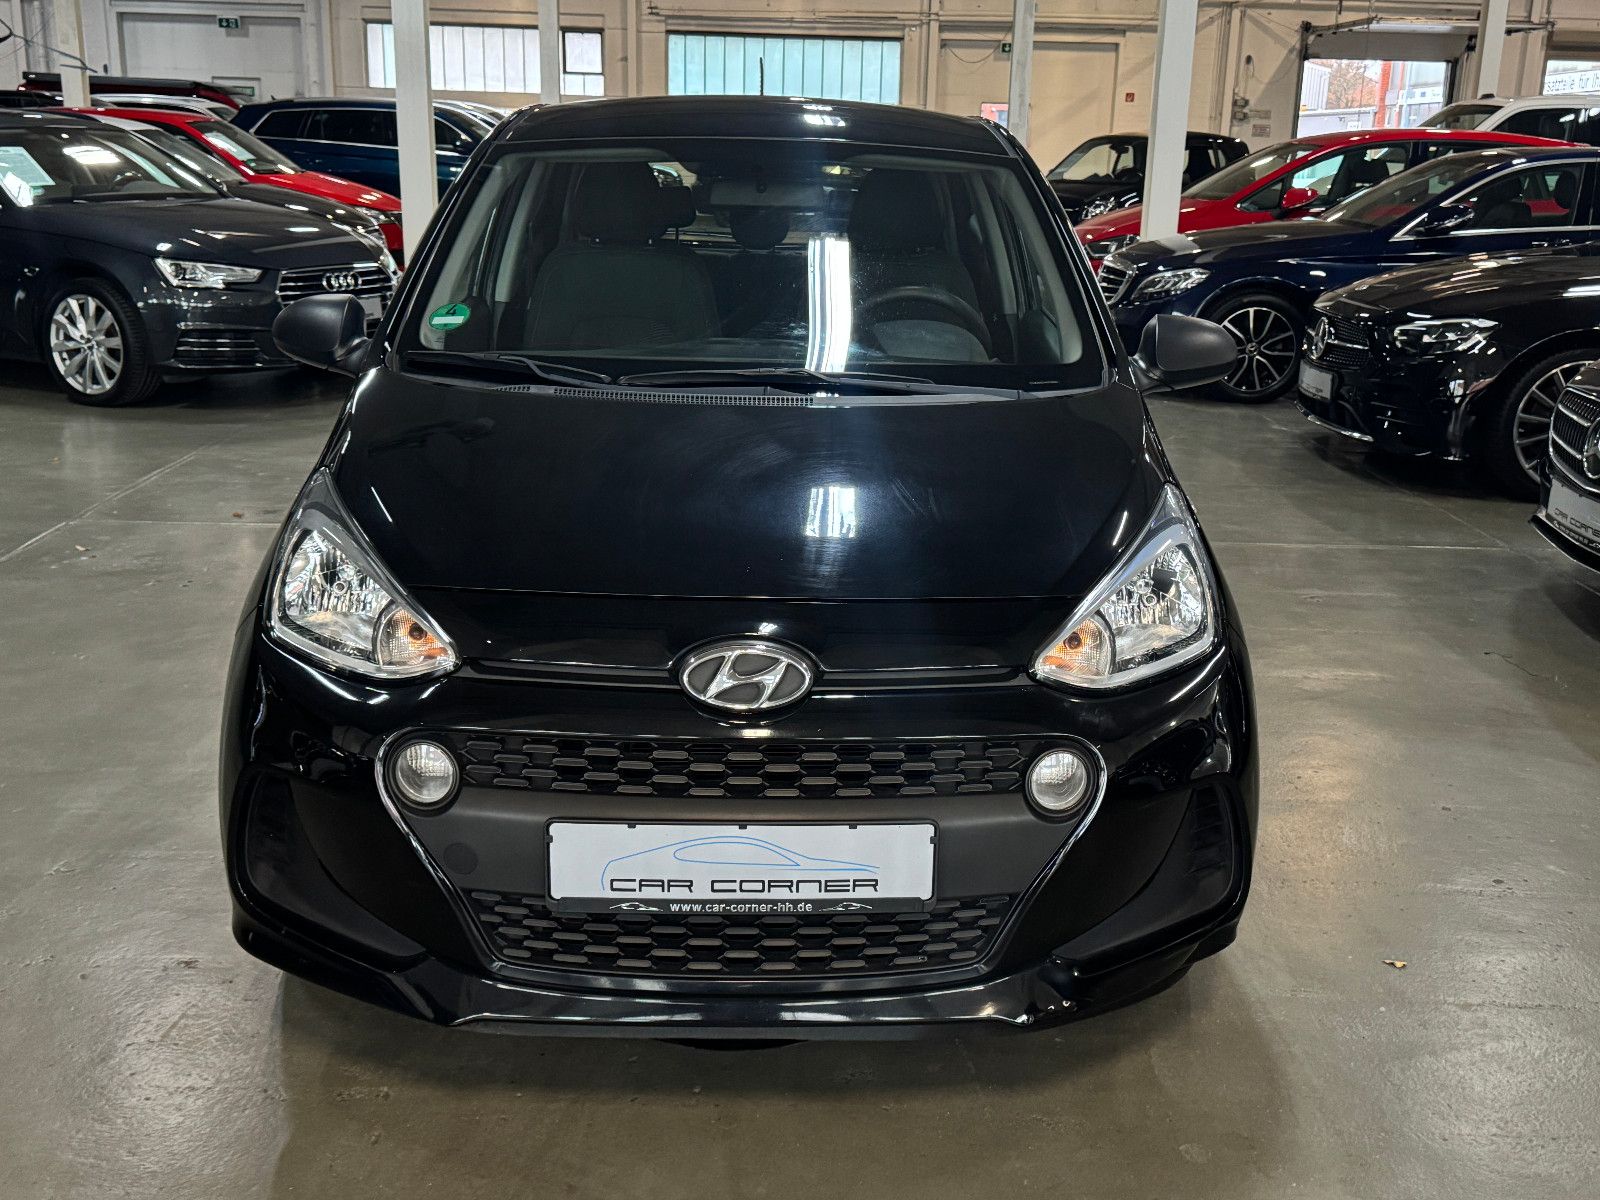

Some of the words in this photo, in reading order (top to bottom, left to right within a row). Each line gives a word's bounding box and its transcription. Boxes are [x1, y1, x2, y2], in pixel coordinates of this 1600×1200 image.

[446, 304, 456, 316] 4
[610, 878, 694, 893] CAR
[711, 878, 879, 893] CORNER
[669, 902, 813, 913] www.car-corner-hh.de
